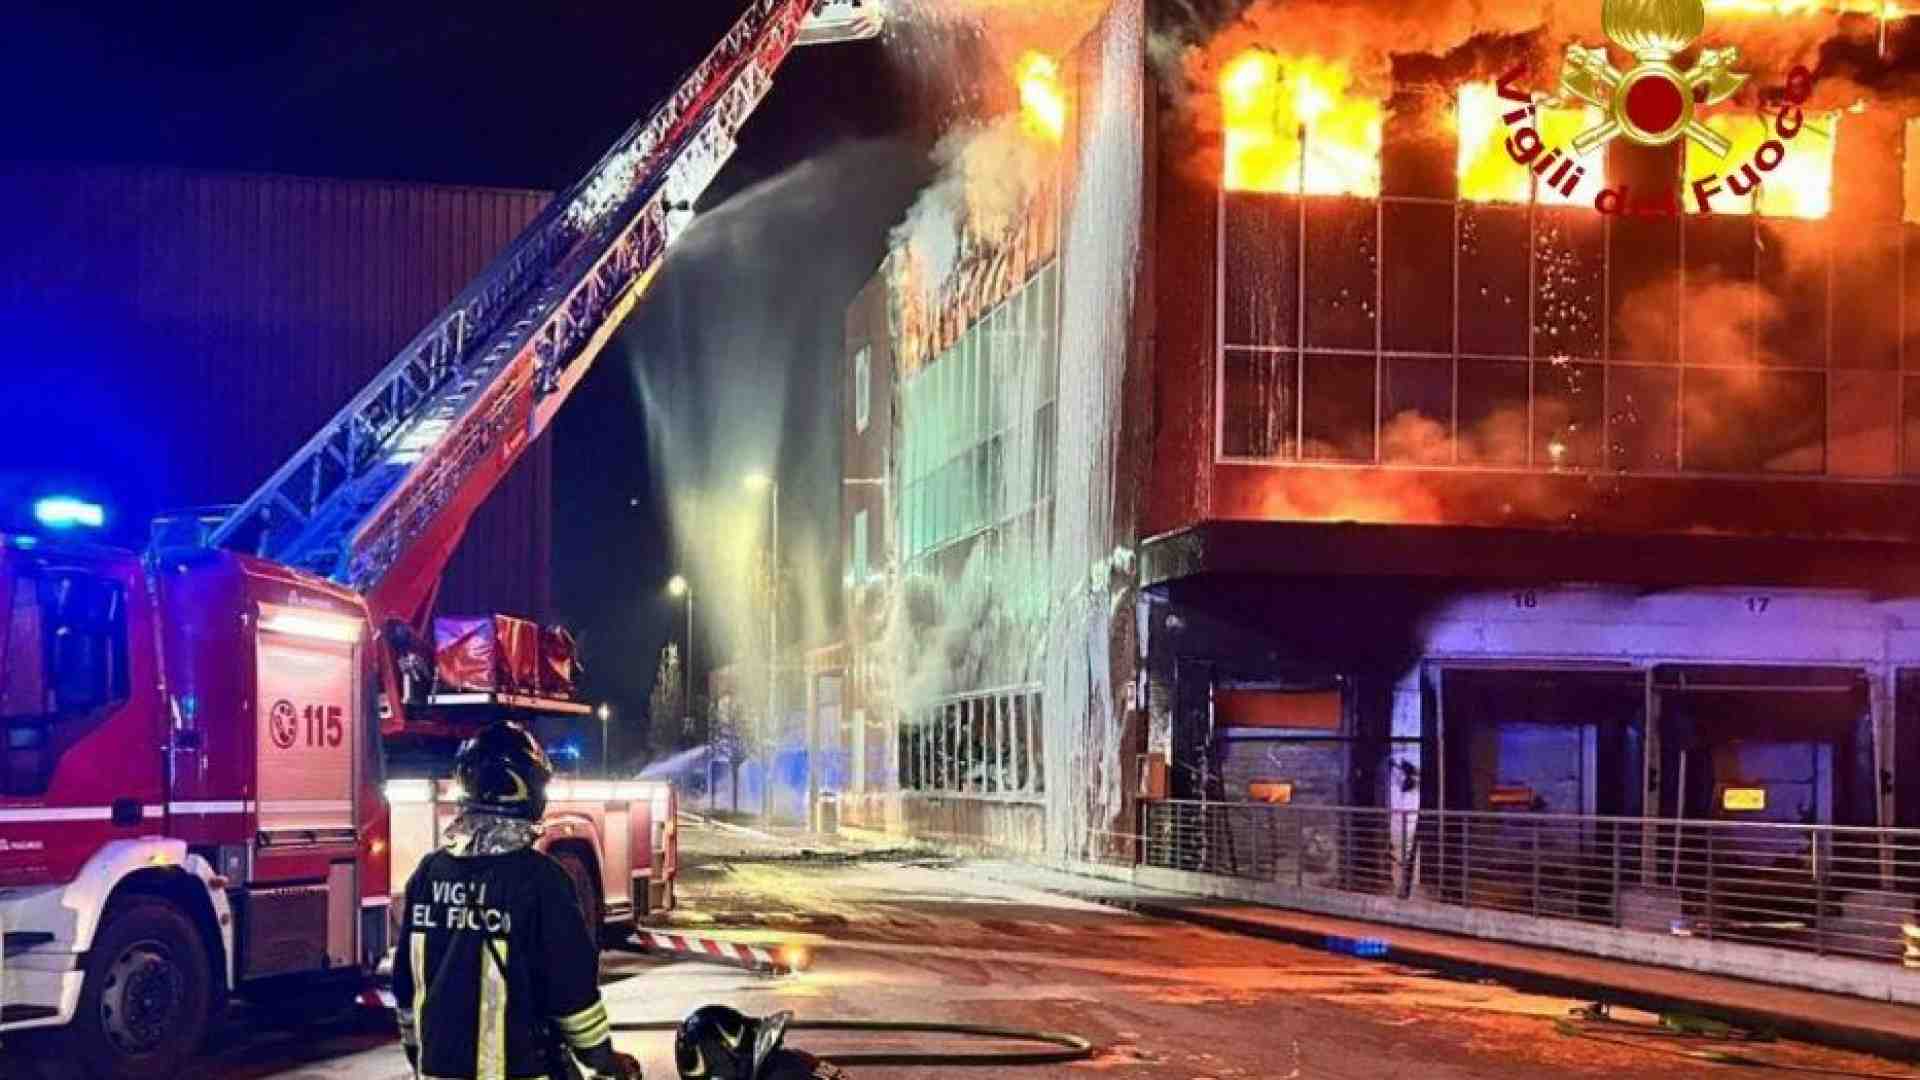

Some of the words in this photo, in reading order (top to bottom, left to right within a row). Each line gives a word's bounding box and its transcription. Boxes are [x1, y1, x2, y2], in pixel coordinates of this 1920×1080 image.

[1747, 596, 1769, 613] 17
[304, 704, 343, 747] 115
[432, 880, 487, 905] VIGI
[412, 904, 436, 927] EL
